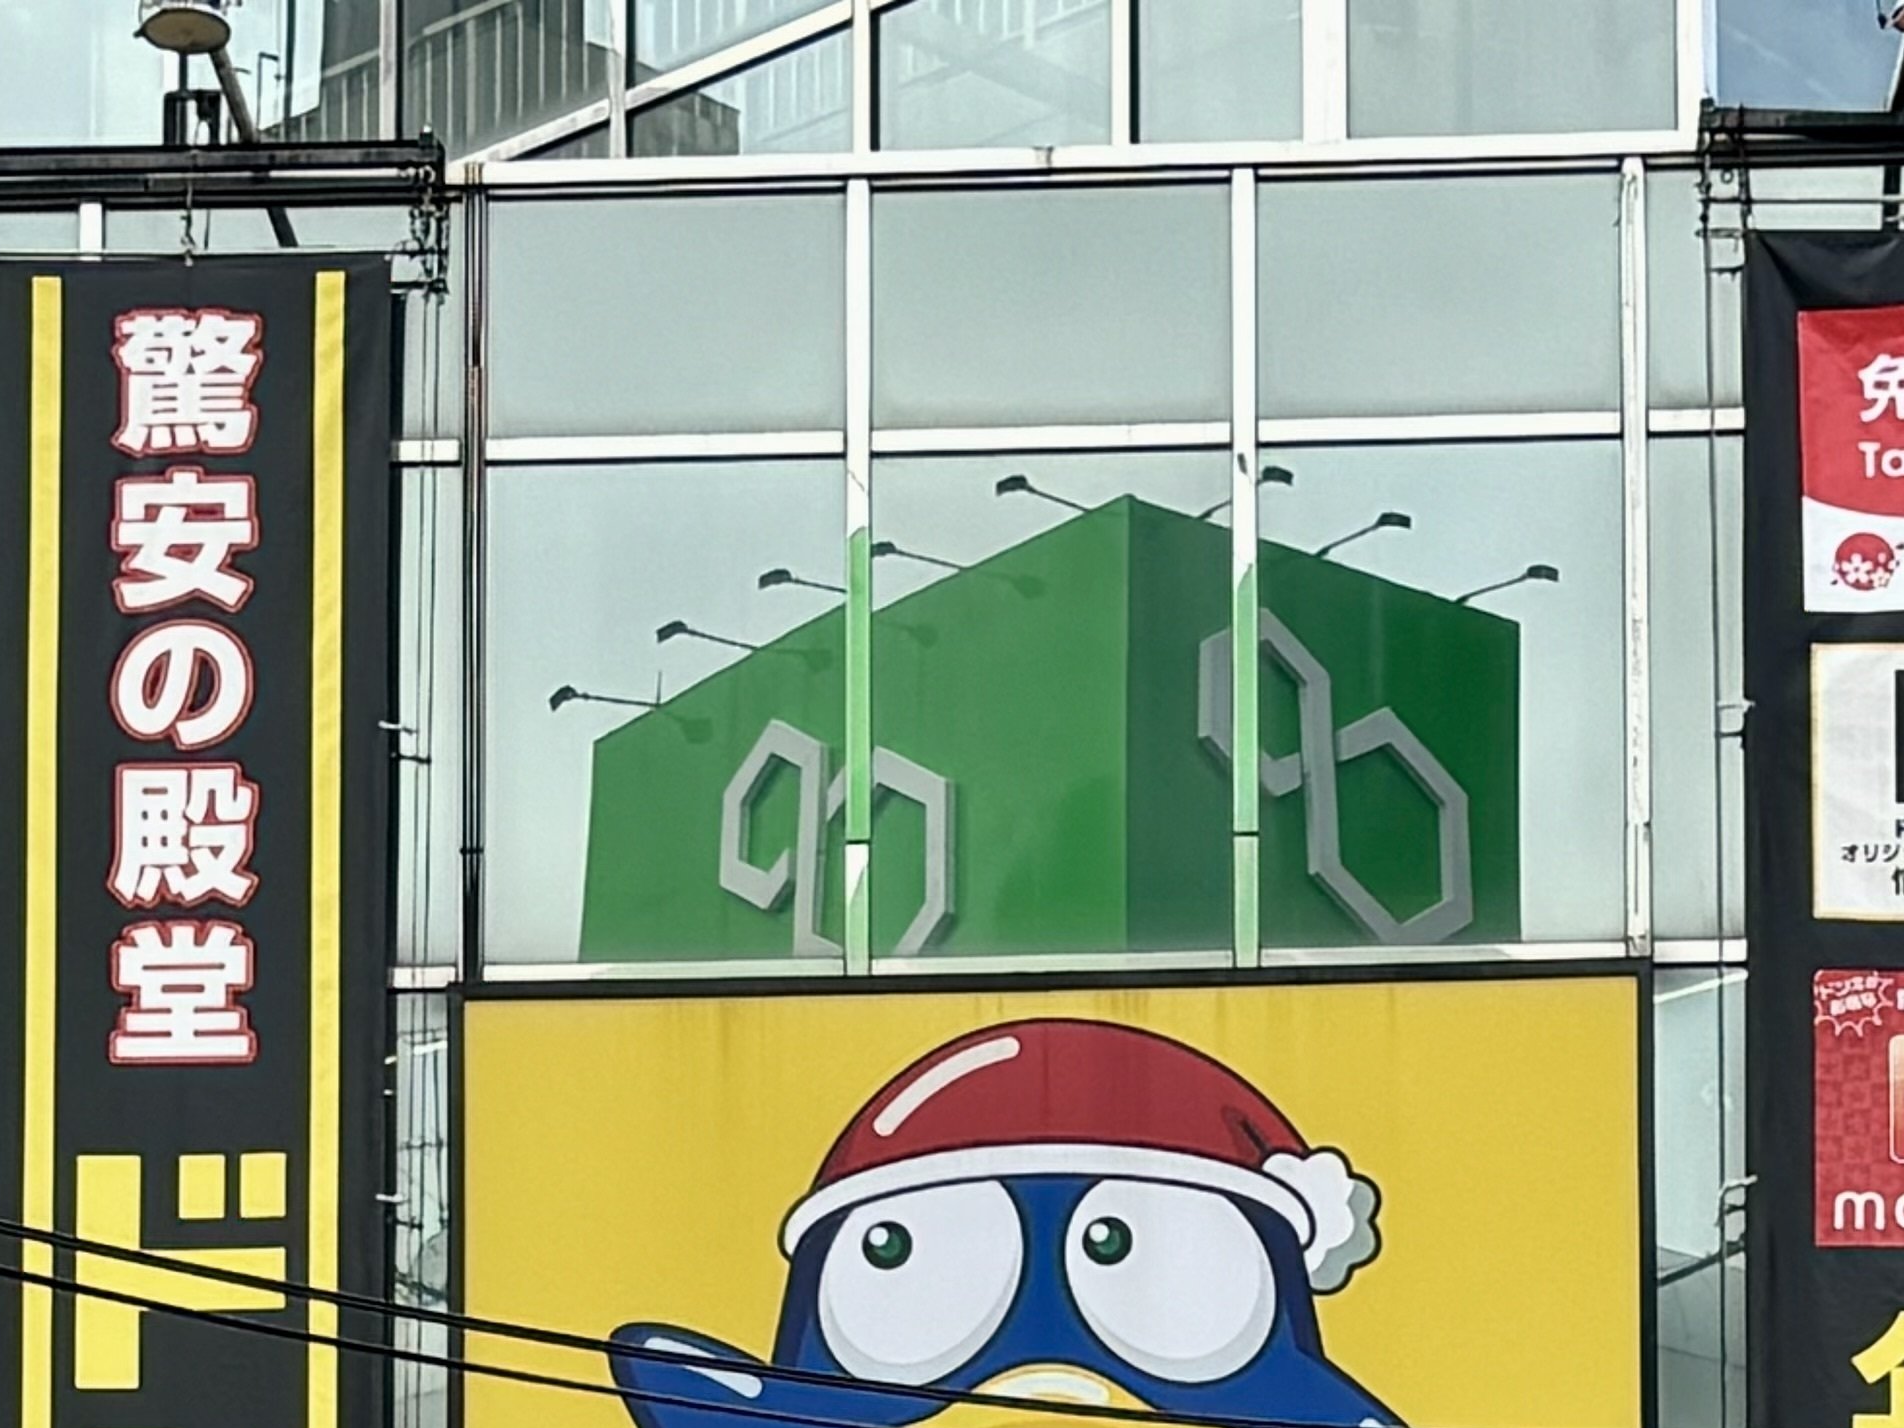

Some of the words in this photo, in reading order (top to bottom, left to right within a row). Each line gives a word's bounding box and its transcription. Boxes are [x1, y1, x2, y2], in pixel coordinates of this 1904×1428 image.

[108, 307, 262, 1064] 驚安の殿堂
